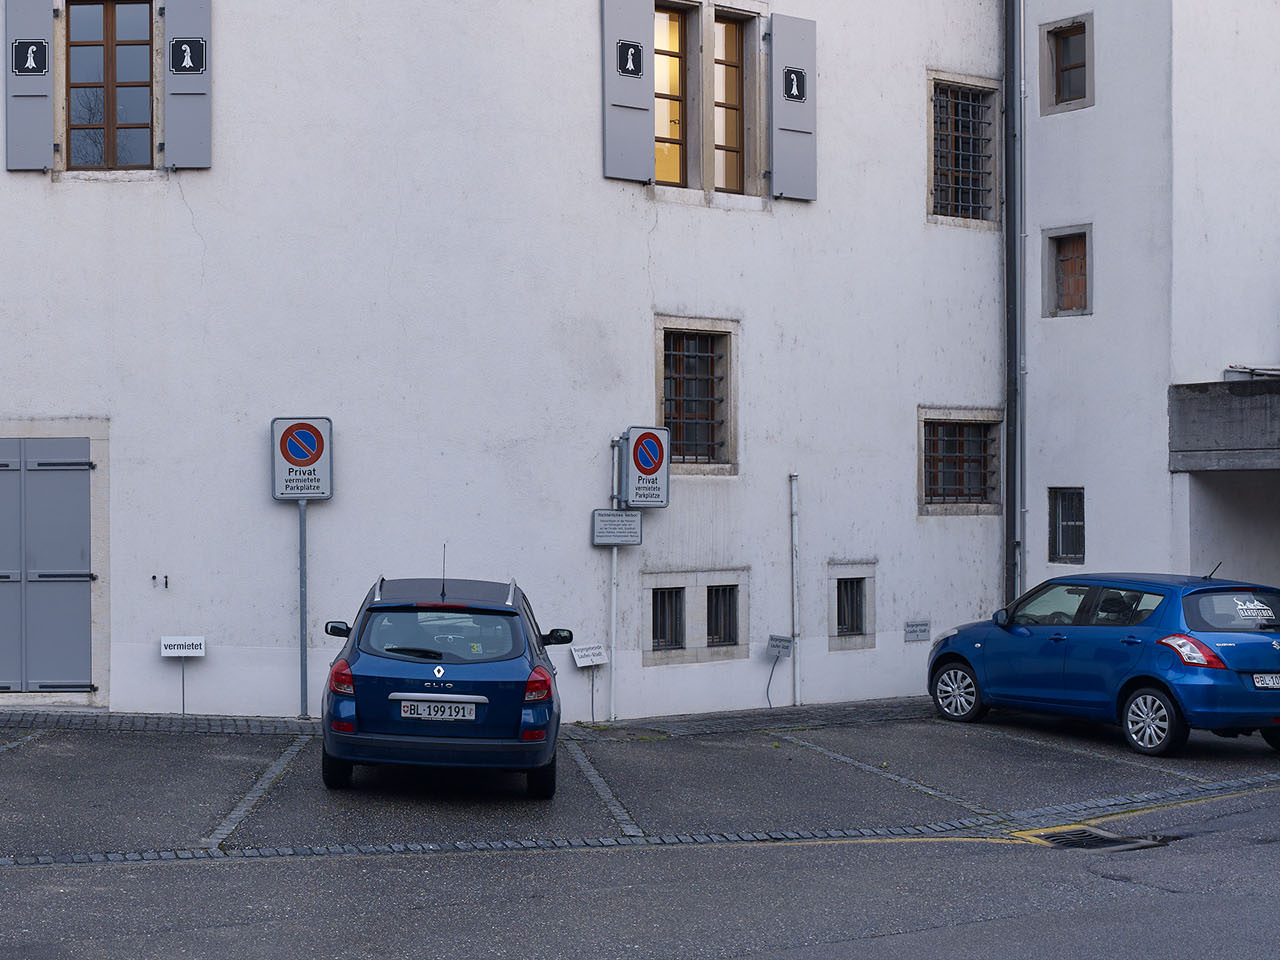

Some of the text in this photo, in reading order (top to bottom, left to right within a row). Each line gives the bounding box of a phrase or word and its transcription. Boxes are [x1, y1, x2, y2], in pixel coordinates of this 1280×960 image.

[288, 467, 317, 476] Privat
[637, 476, 658, 485] Privat
[284, 484, 321, 492] Parkplätze
[163, 641, 202, 650] vermietet
